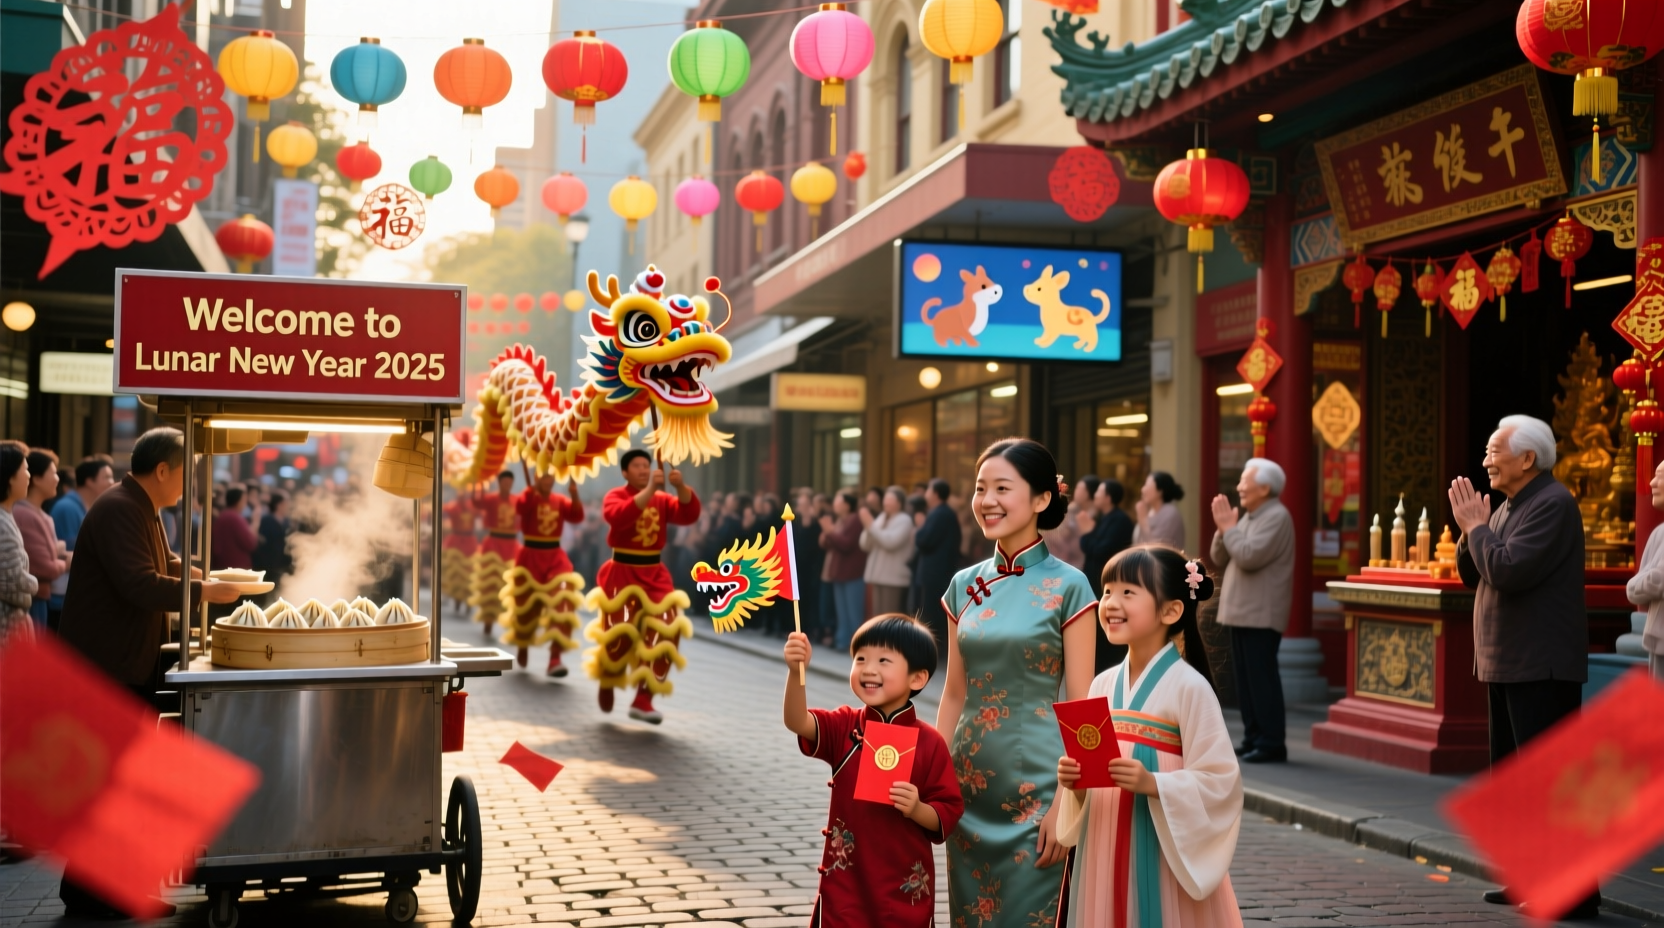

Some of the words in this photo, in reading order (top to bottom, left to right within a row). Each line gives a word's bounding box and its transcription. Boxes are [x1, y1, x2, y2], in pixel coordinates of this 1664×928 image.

[46, 58, 196, 203] 福
[371, 192, 413, 239] 福
[1449, 268, 1480, 311] 福
[183, 296, 355, 337] Welcome
[364, 307, 401, 338] to
[135, 342, 220, 372] Lunar
[229, 346, 295, 375] New
[302, 349, 367, 378] Year
[374, 351, 445, 381] 2025
